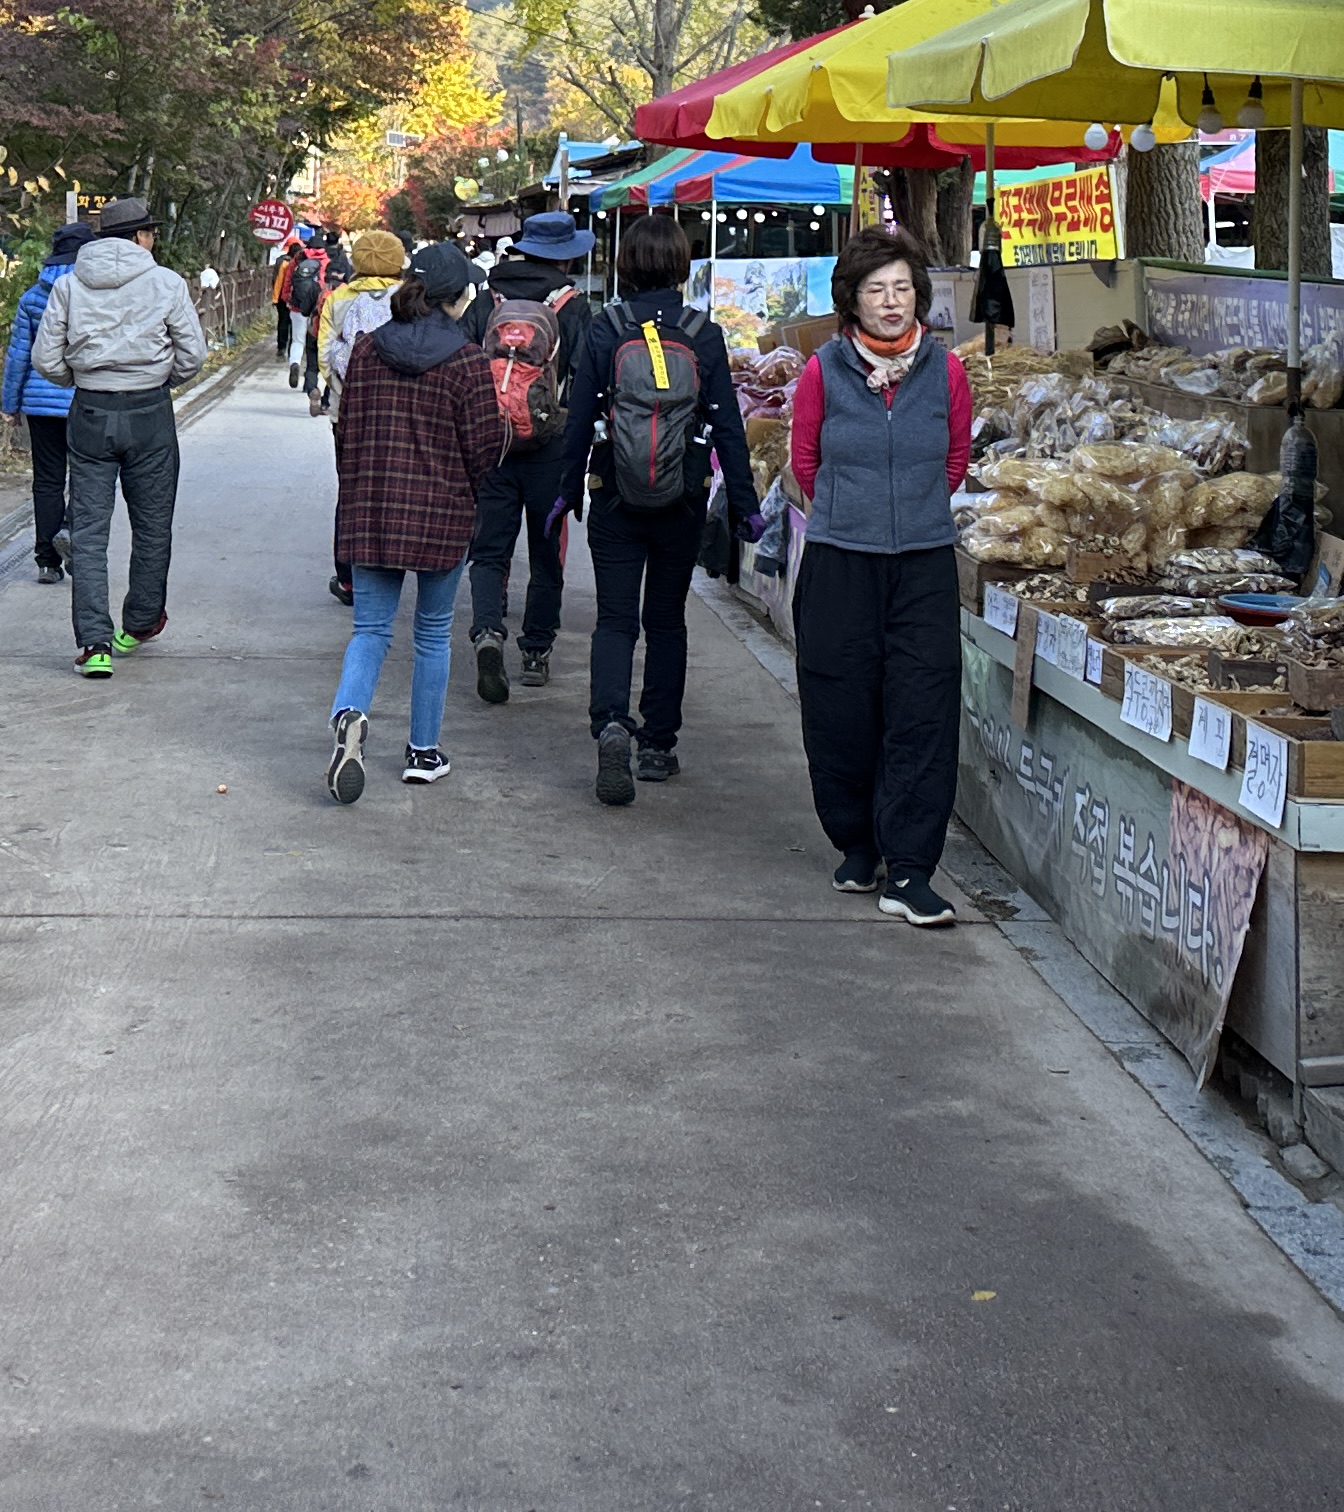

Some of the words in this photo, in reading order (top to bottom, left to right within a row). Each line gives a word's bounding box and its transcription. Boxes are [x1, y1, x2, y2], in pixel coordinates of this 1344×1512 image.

[77, 194, 118, 209] 화장
[1246, 736, 1284, 812] 결명자
[1070, 781, 1110, 899] 직접
